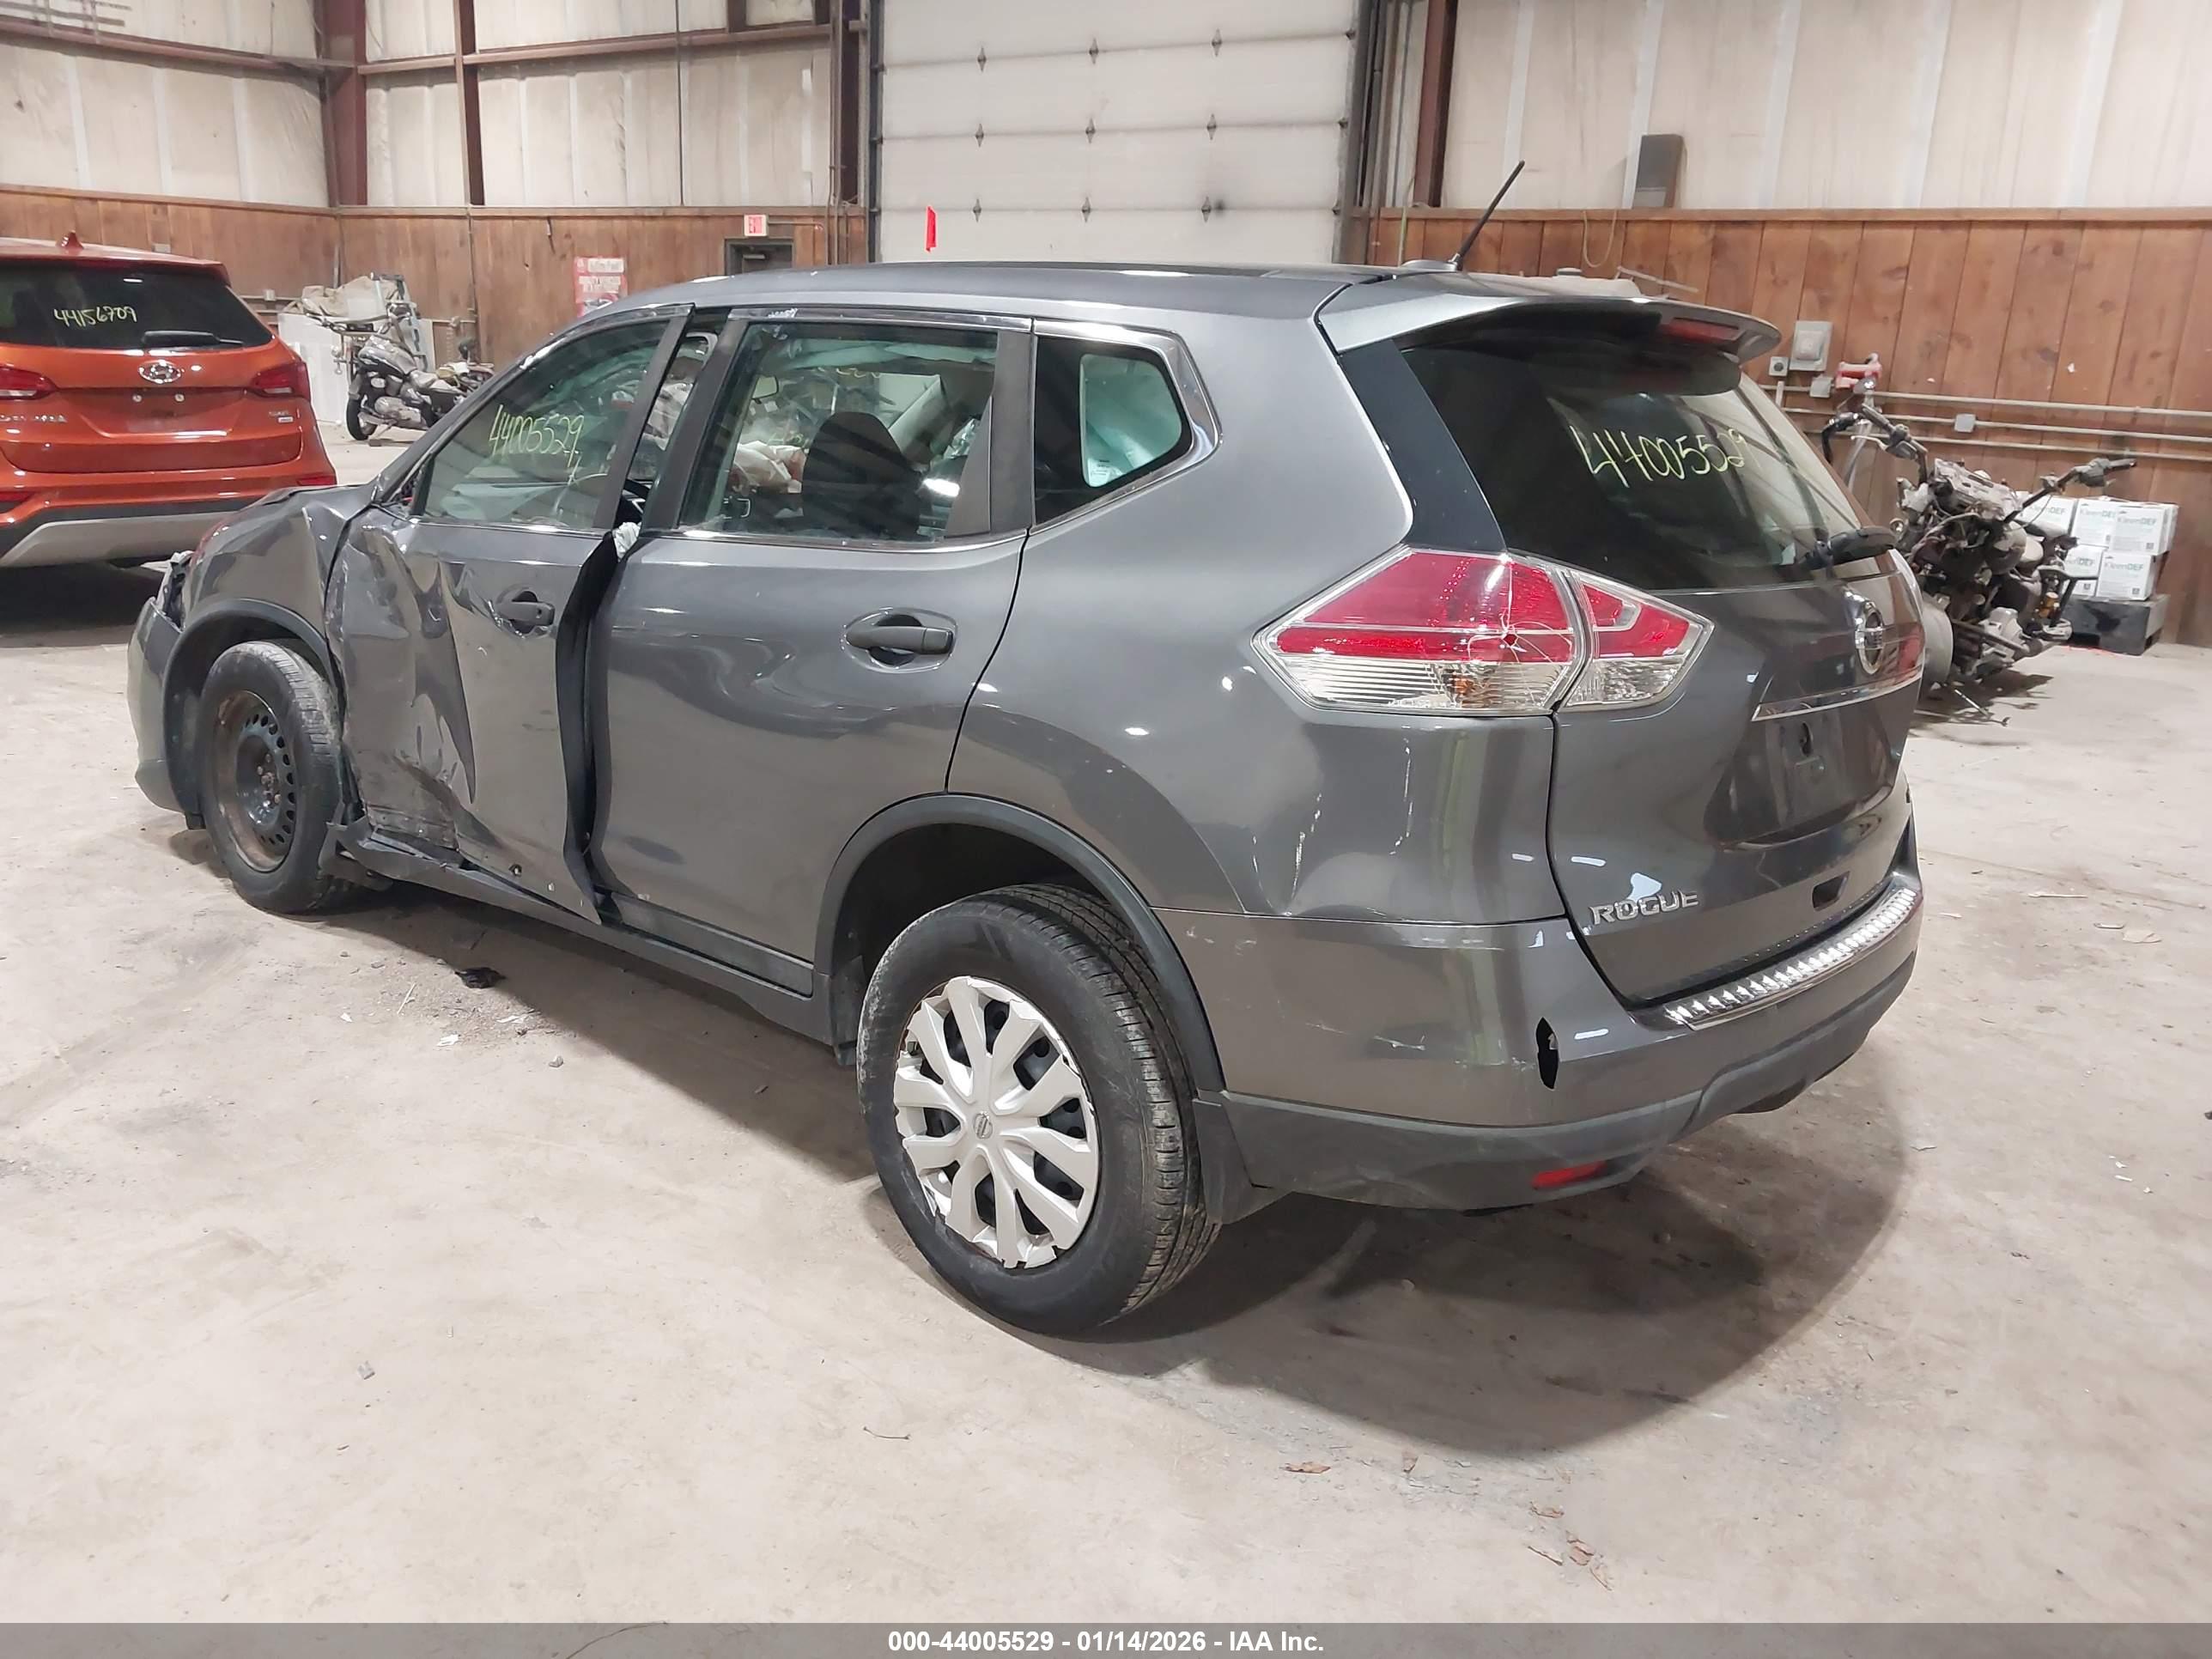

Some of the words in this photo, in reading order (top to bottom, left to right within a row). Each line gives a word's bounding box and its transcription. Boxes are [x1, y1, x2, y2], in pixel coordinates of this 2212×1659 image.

[53, 306, 137, 327] 44156709
[489, 404, 585, 468] 44005529
[1570, 425, 1760, 488] 44005529
[1589, 890, 1699, 925] ROGUE
